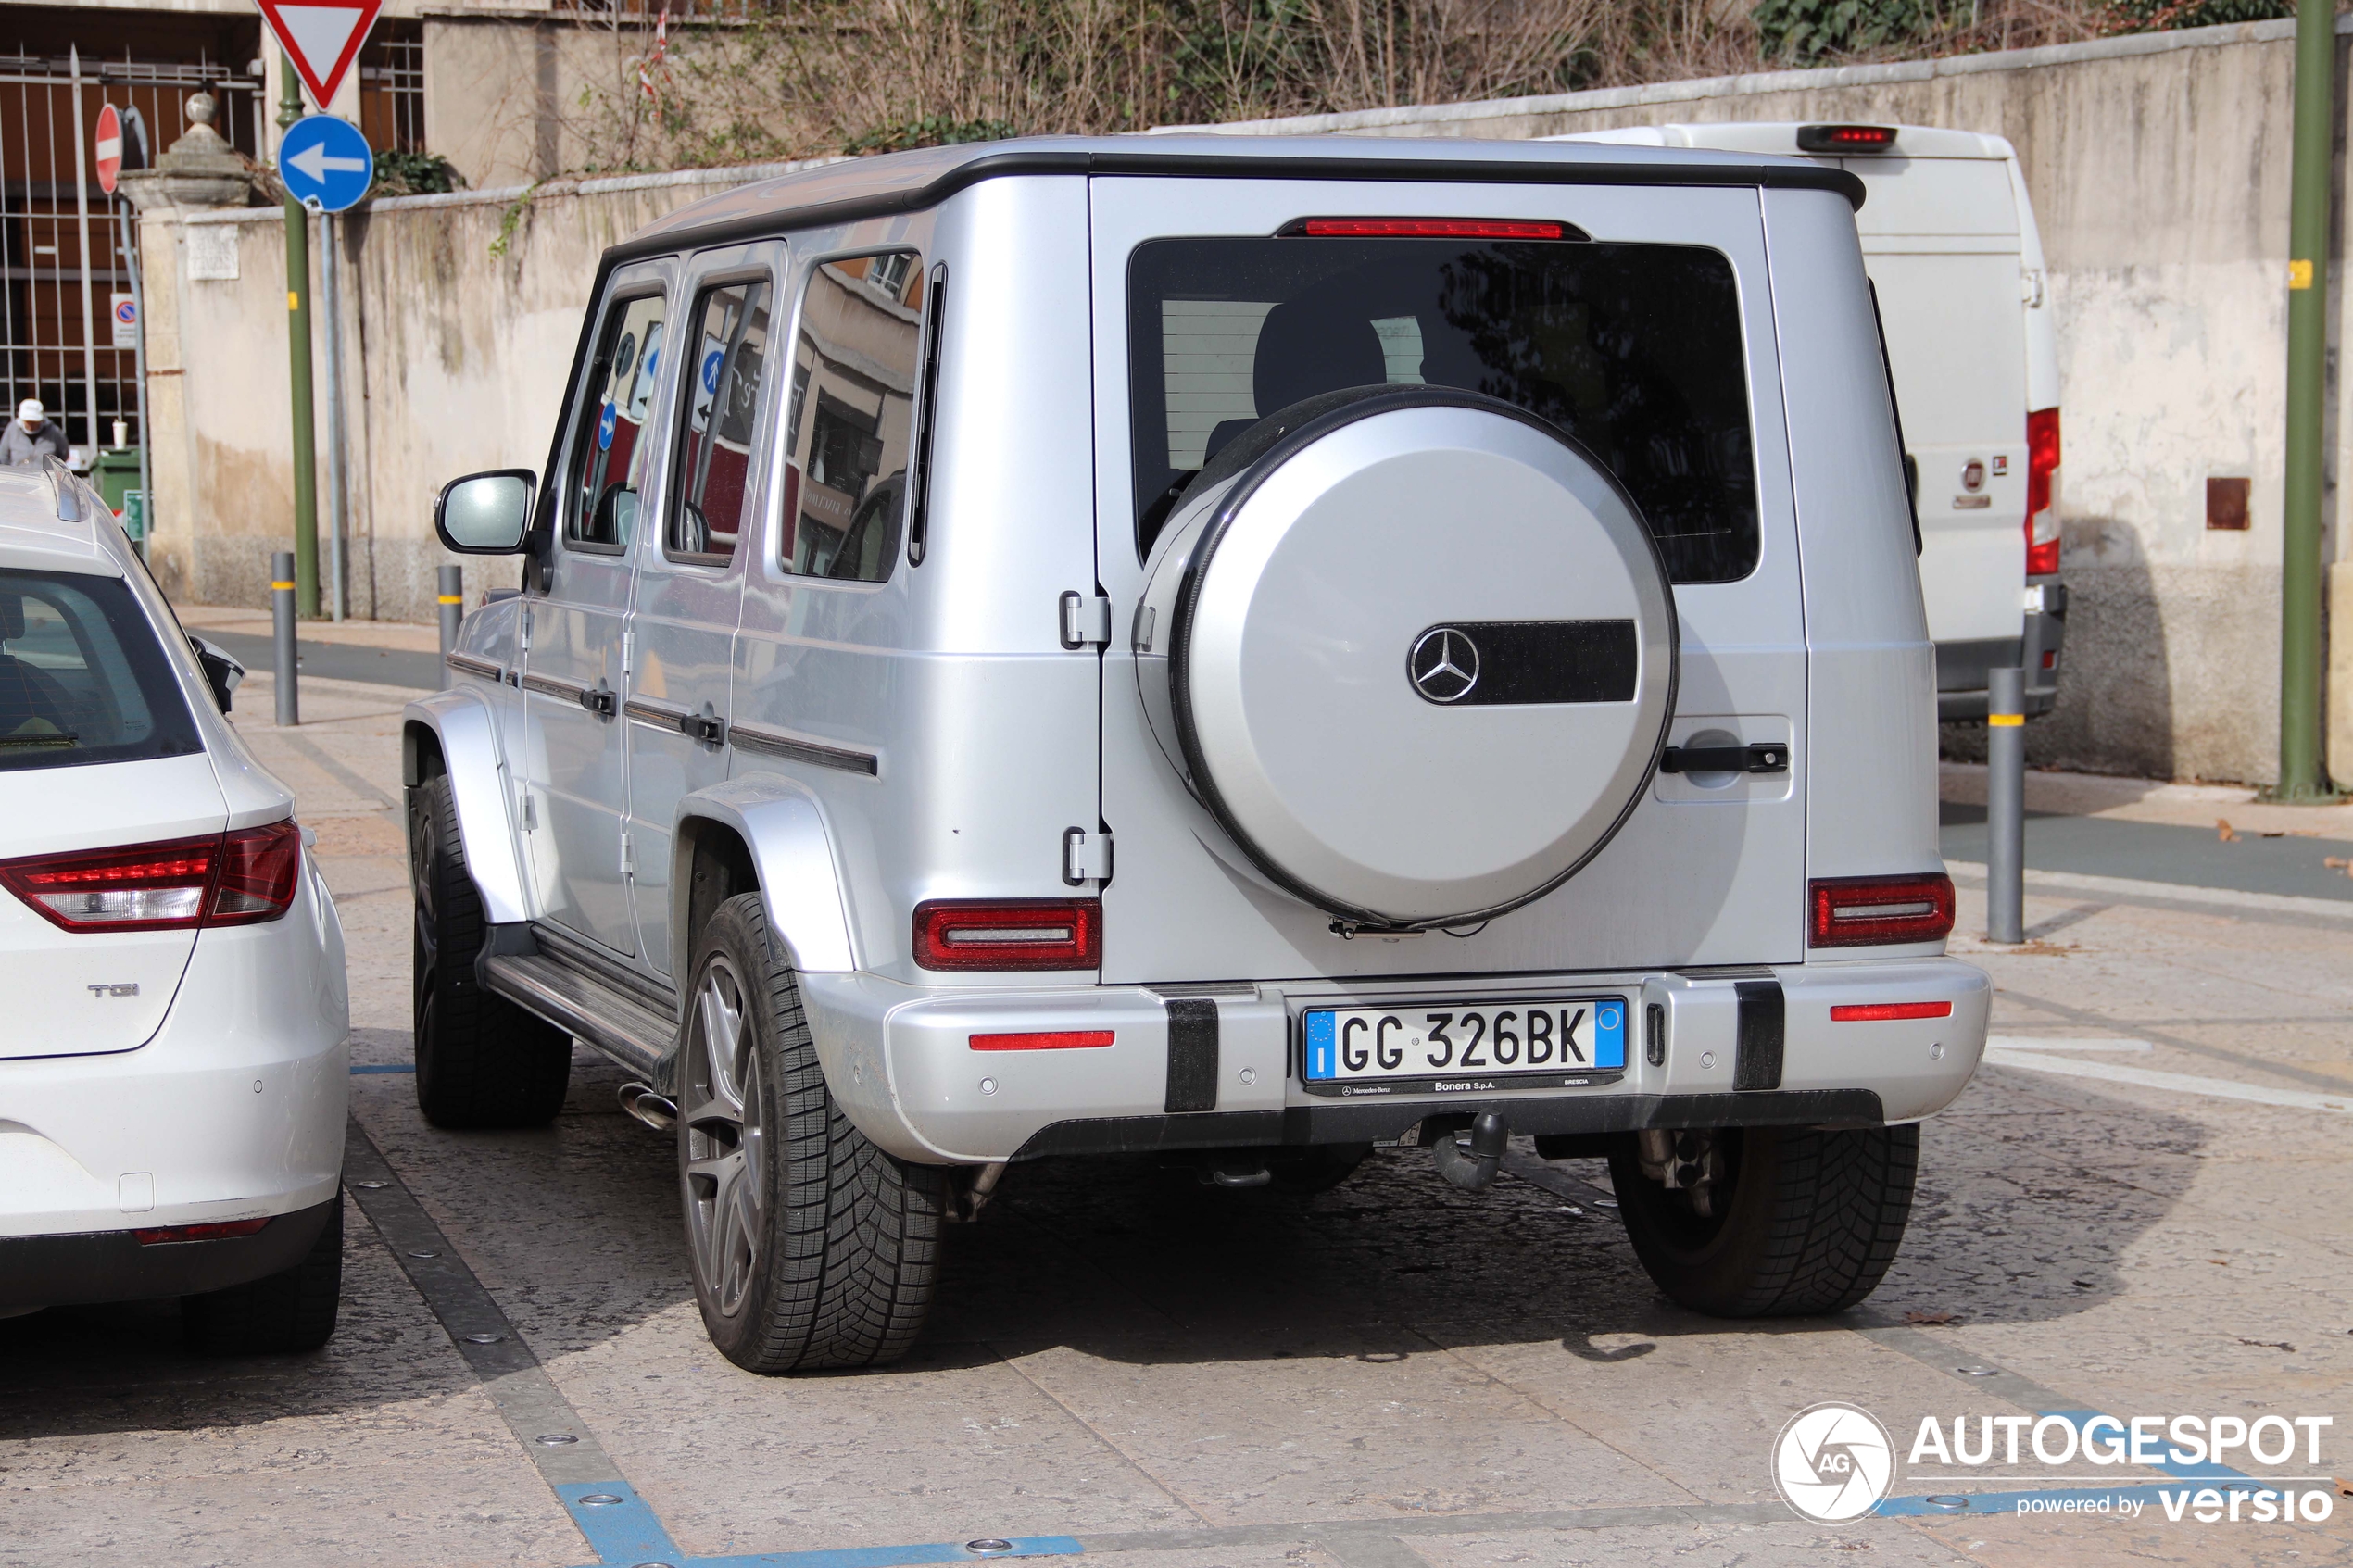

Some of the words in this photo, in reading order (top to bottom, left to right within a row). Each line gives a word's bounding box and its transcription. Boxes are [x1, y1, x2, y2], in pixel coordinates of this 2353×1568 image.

[1342, 1016, 1403, 1072] GG
[1426, 1008, 1586, 1068] 326BK
[1317, 1047, 1325, 1073] I
[1434, 1082, 1471, 1092] Bonera
[1473, 1081, 1496, 1091] S.p.A.
